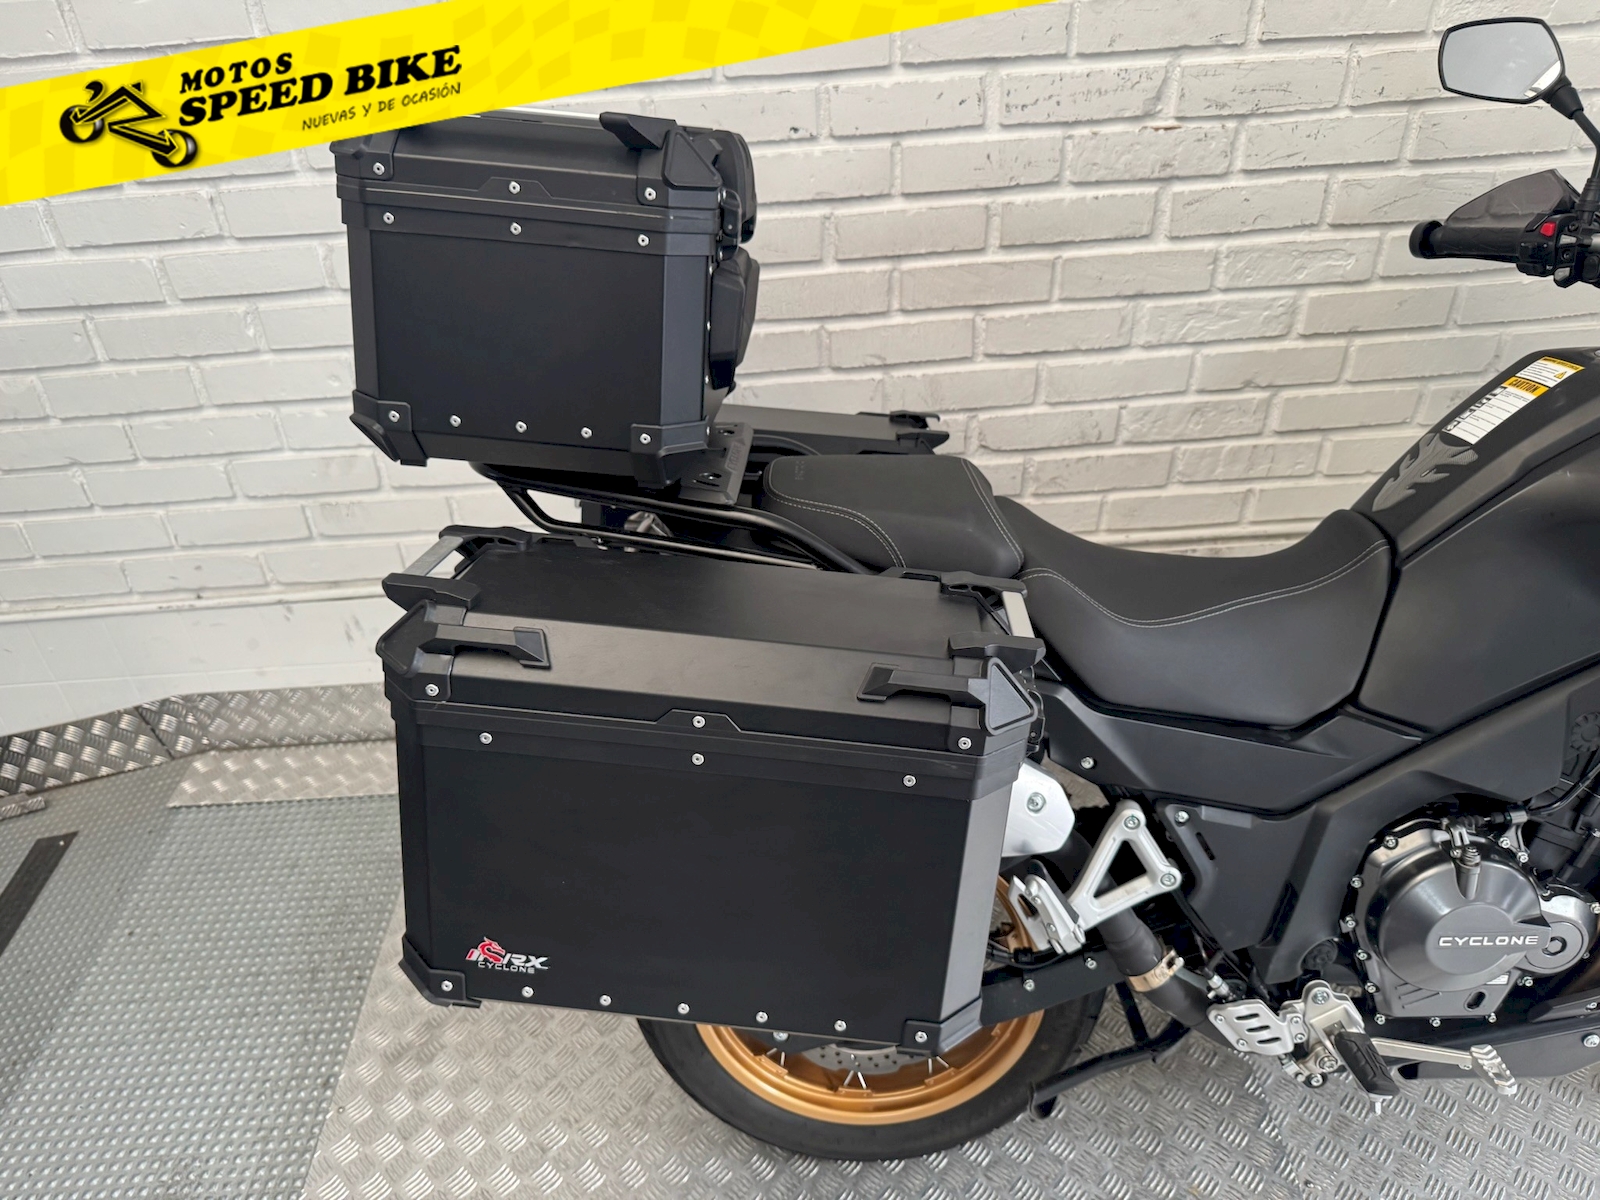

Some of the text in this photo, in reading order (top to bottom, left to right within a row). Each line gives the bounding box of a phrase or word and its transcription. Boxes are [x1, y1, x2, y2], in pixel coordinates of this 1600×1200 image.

[1508, 379, 1541, 394] CAUTION
[1439, 935, 1539, 946] CYCLONE
[478, 961, 535, 974] CYCLONE
